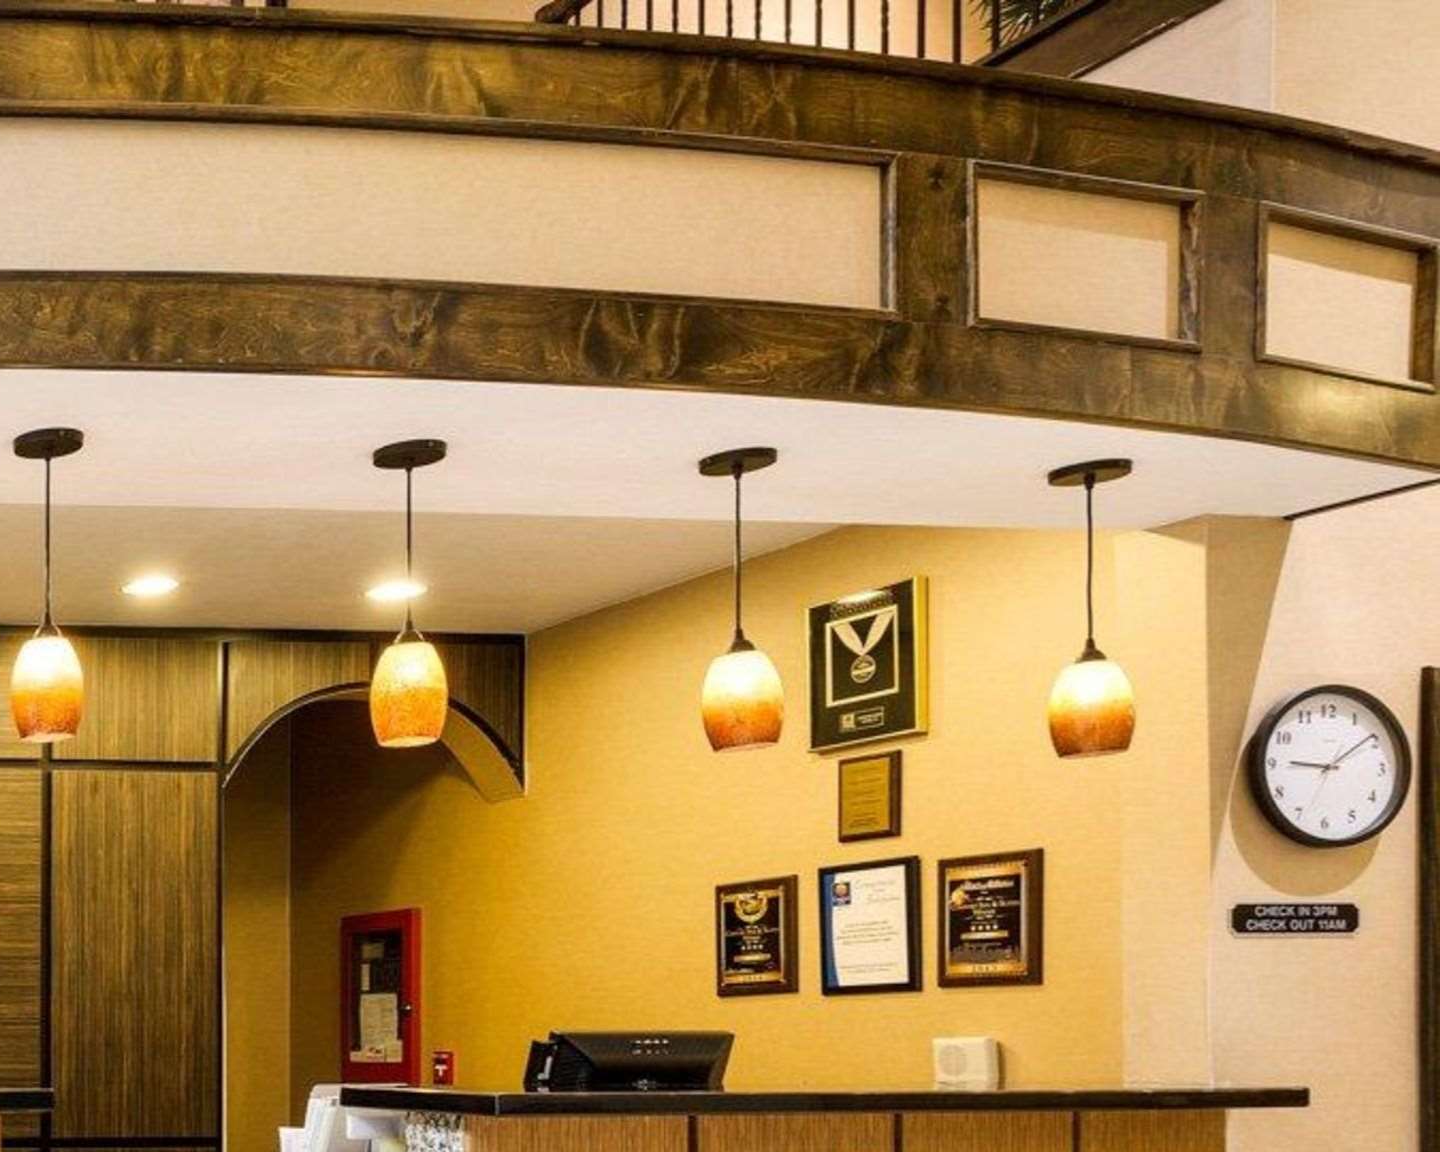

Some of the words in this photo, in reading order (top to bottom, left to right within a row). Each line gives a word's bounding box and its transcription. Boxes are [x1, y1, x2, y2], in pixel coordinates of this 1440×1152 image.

[1298, 710, 1312, 724] 11
[1320, 704, 1337, 718] 12
[1352, 712, 1358, 725] 1
[1276, 731, 1292, 745] 10
[1267, 757, 1277, 770] 9
[1376, 763, 1386, 777] 3
[1274, 786, 1285, 800] 8
[1367, 789, 1377, 802] 4
[1294, 807, 1303, 821] 7
[1347, 810, 1357, 824] 5
[1320, 816, 1329, 829] 6
[1255, 906, 1295, 917] CHECK
[1297, 906, 1311, 917] IN
[1312, 906, 1338, 917] 3PM
[1246, 919, 1287, 931] CHECK
[1289, 919, 1316, 931] OUT
